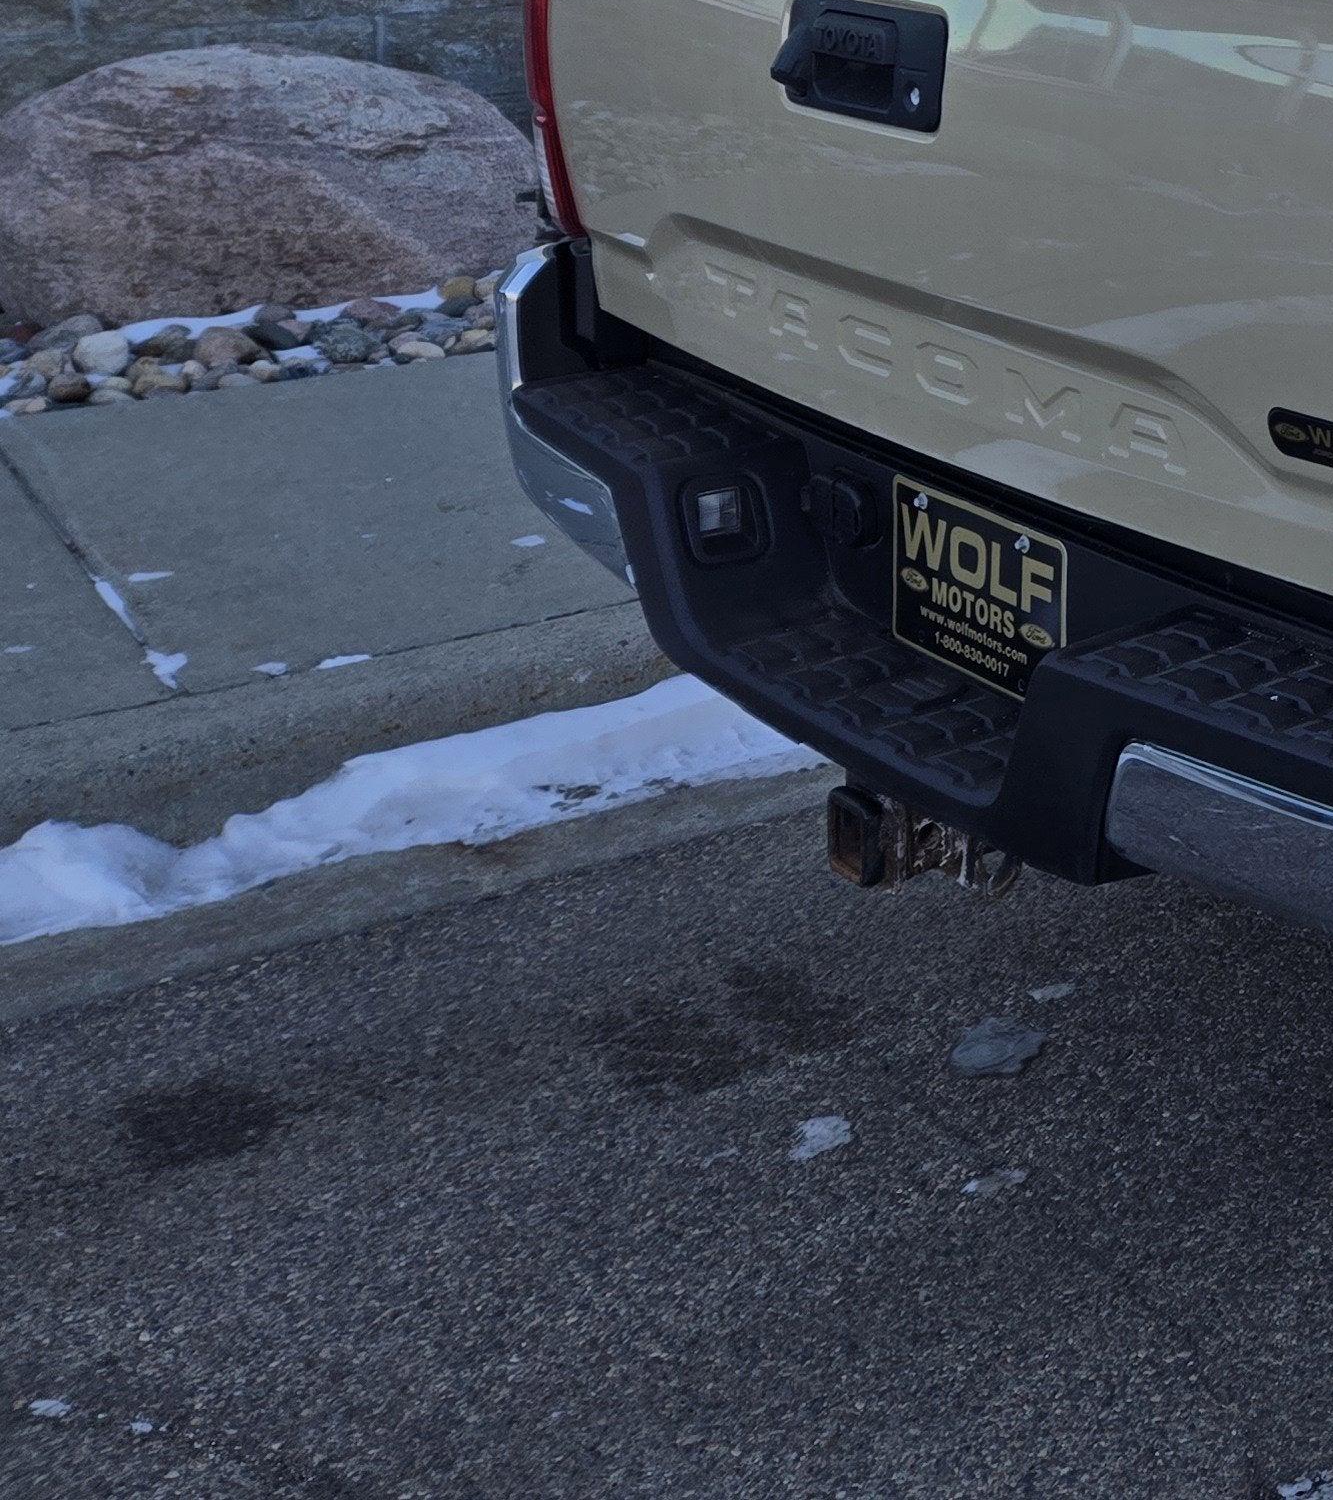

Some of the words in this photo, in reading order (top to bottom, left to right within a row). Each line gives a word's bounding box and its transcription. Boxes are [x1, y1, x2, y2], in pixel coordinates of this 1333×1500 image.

[814, 27, 880, 57] TOYOTA
[702, 258, 1190, 476] TACOMA
[901, 501, 1055, 614] WOLF
[919, 604, 1028, 665] www.wolfmotors.com
[931, 577, 1016, 639] MOTORS
[934, 631, 1010, 677] 1-800-830-0017
